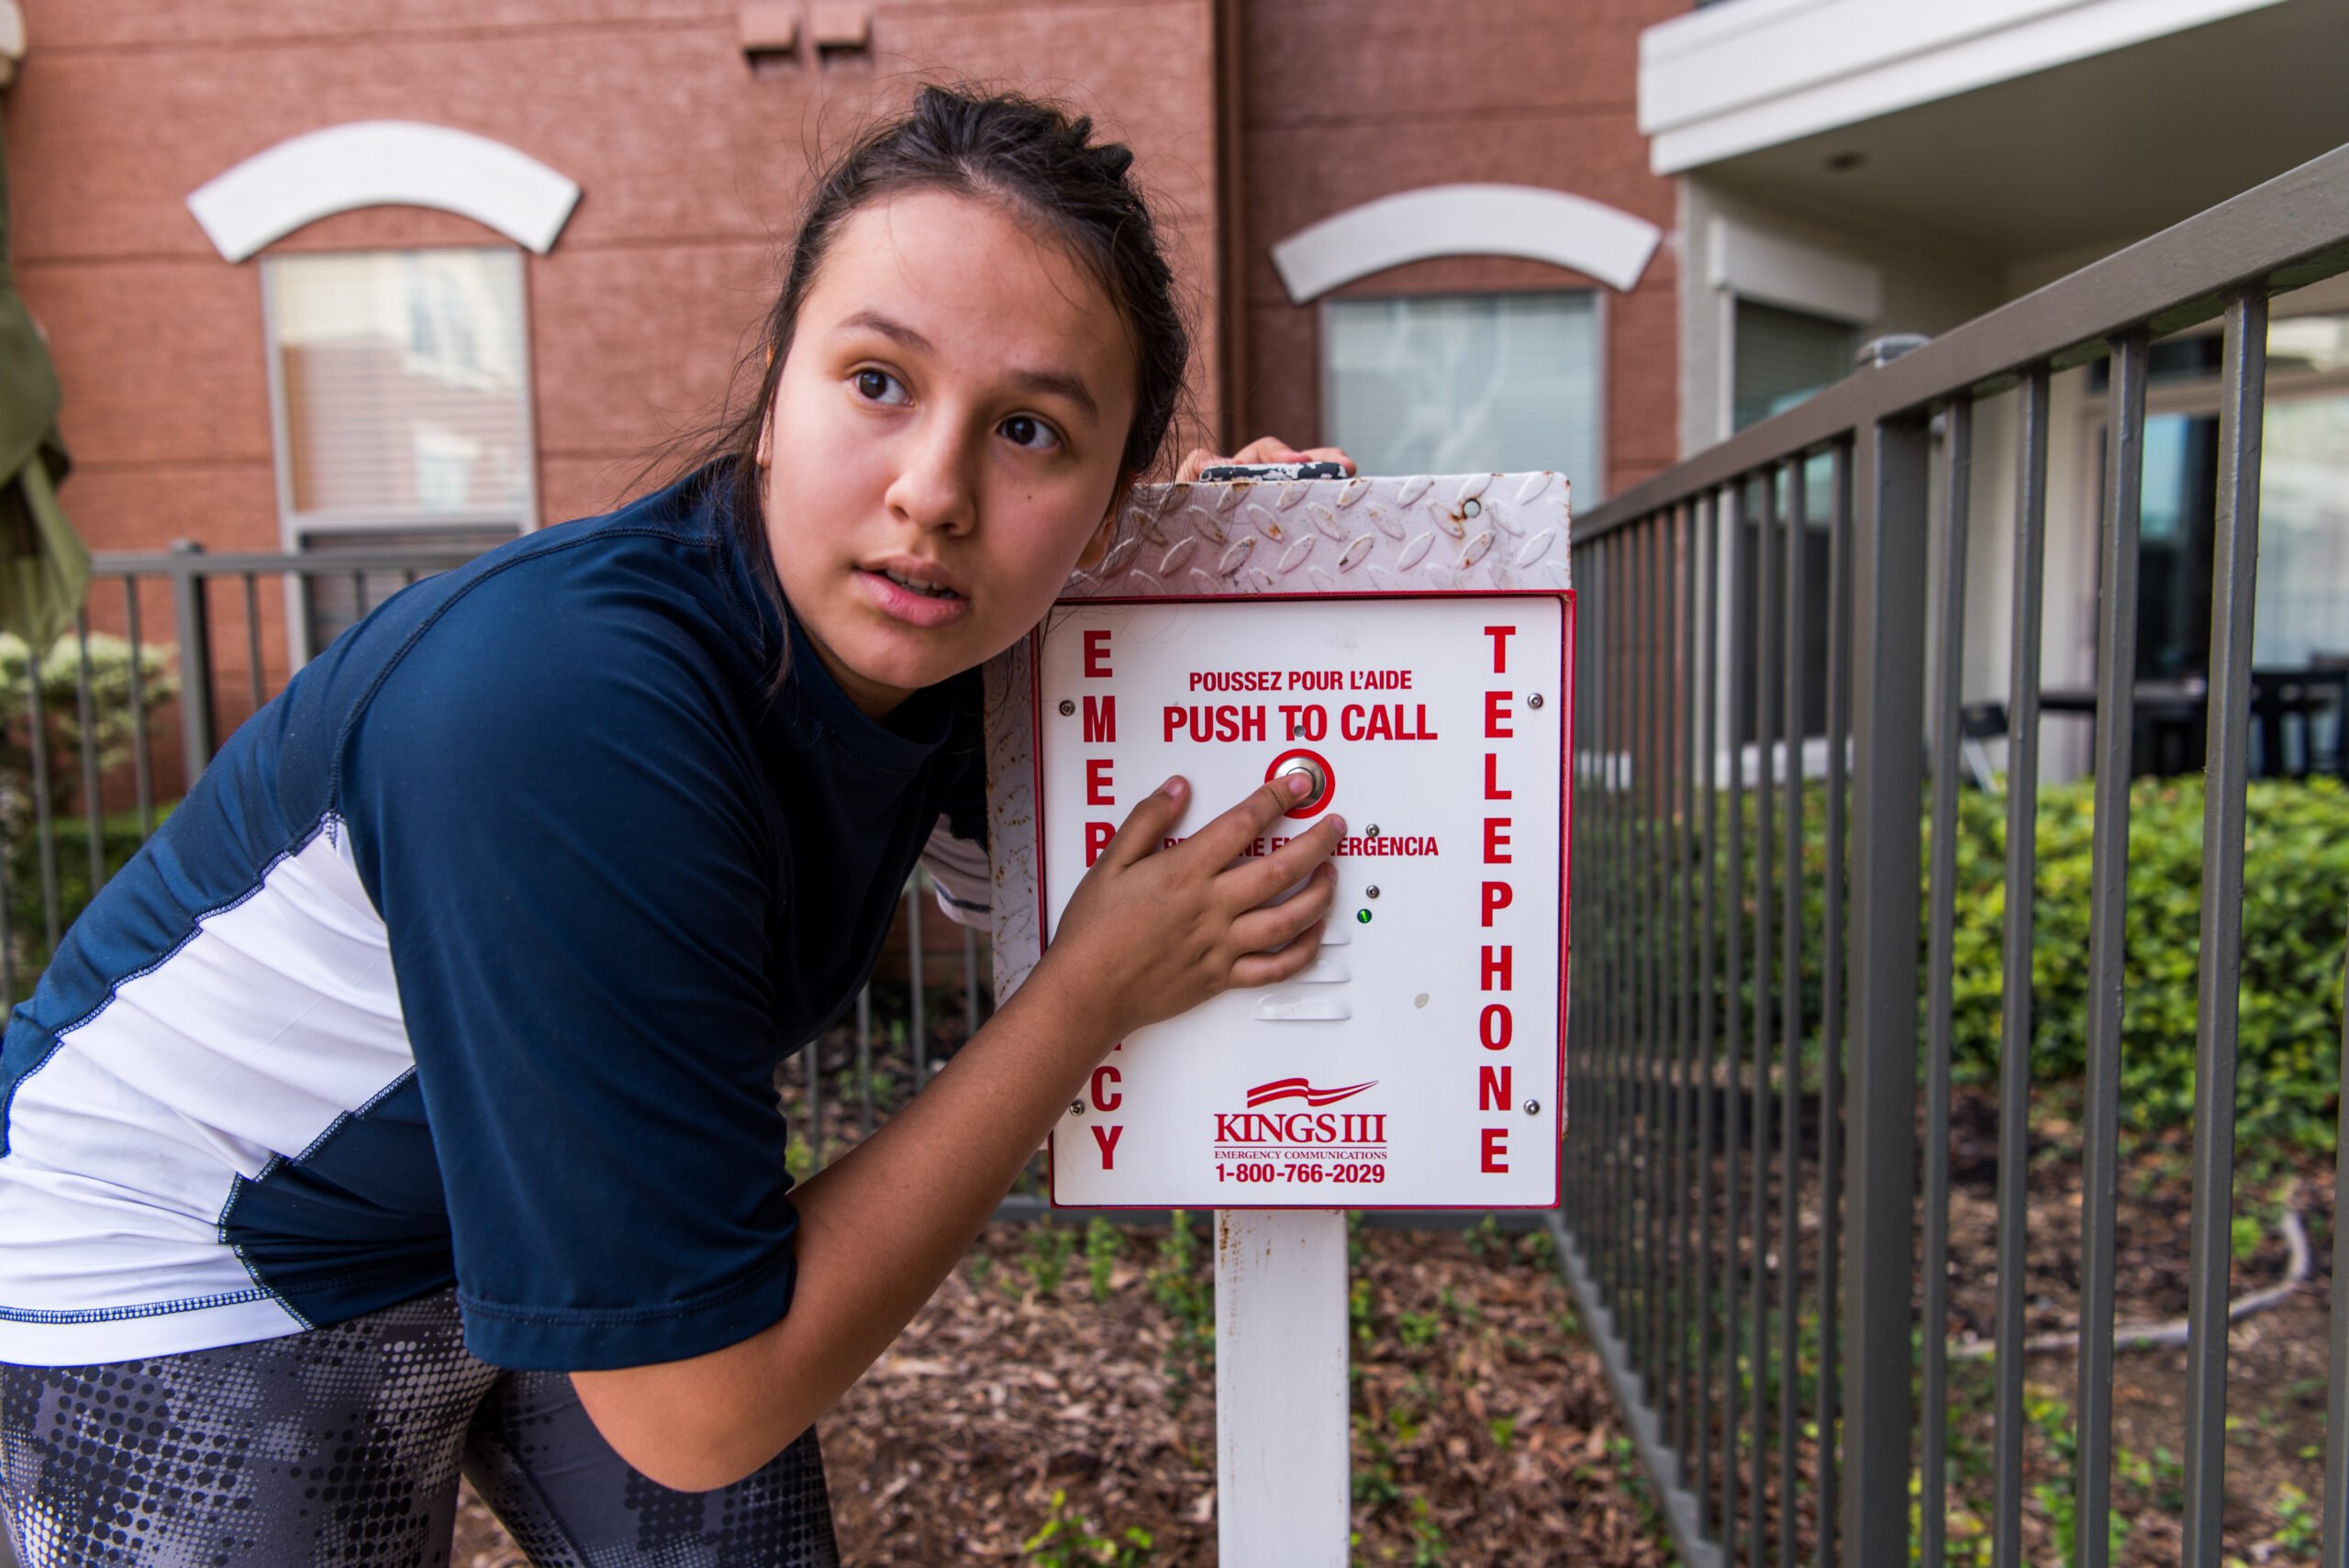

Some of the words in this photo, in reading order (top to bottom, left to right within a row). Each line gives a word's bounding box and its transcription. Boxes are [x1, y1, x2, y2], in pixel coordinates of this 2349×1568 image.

[1189, 671, 1283, 692] POUSSEZ
[1288, 670, 1343, 691] POUR
[1350, 670, 1412, 691] L’AIDE
[1163, 705, 1266, 743] PUSH
[1278, 704, 1328, 742] TO
[1341, 704, 1439, 742] CALL
[1330, 836, 1440, 857] ERGENCIA
[1083, 630, 1124, 1171] EMERCY
[1479, 625, 1517, 1173] TELEPHONE
[1214, 1113, 1337, 1143] KINGS
[1341, 1114, 1387, 1143] III
[1214, 1151, 1282, 1160] EMERGENCY
[1285, 1151, 1387, 1160] COMMUNICATIONS
[1215, 1162, 1386, 1184] 1-800-766-2029
